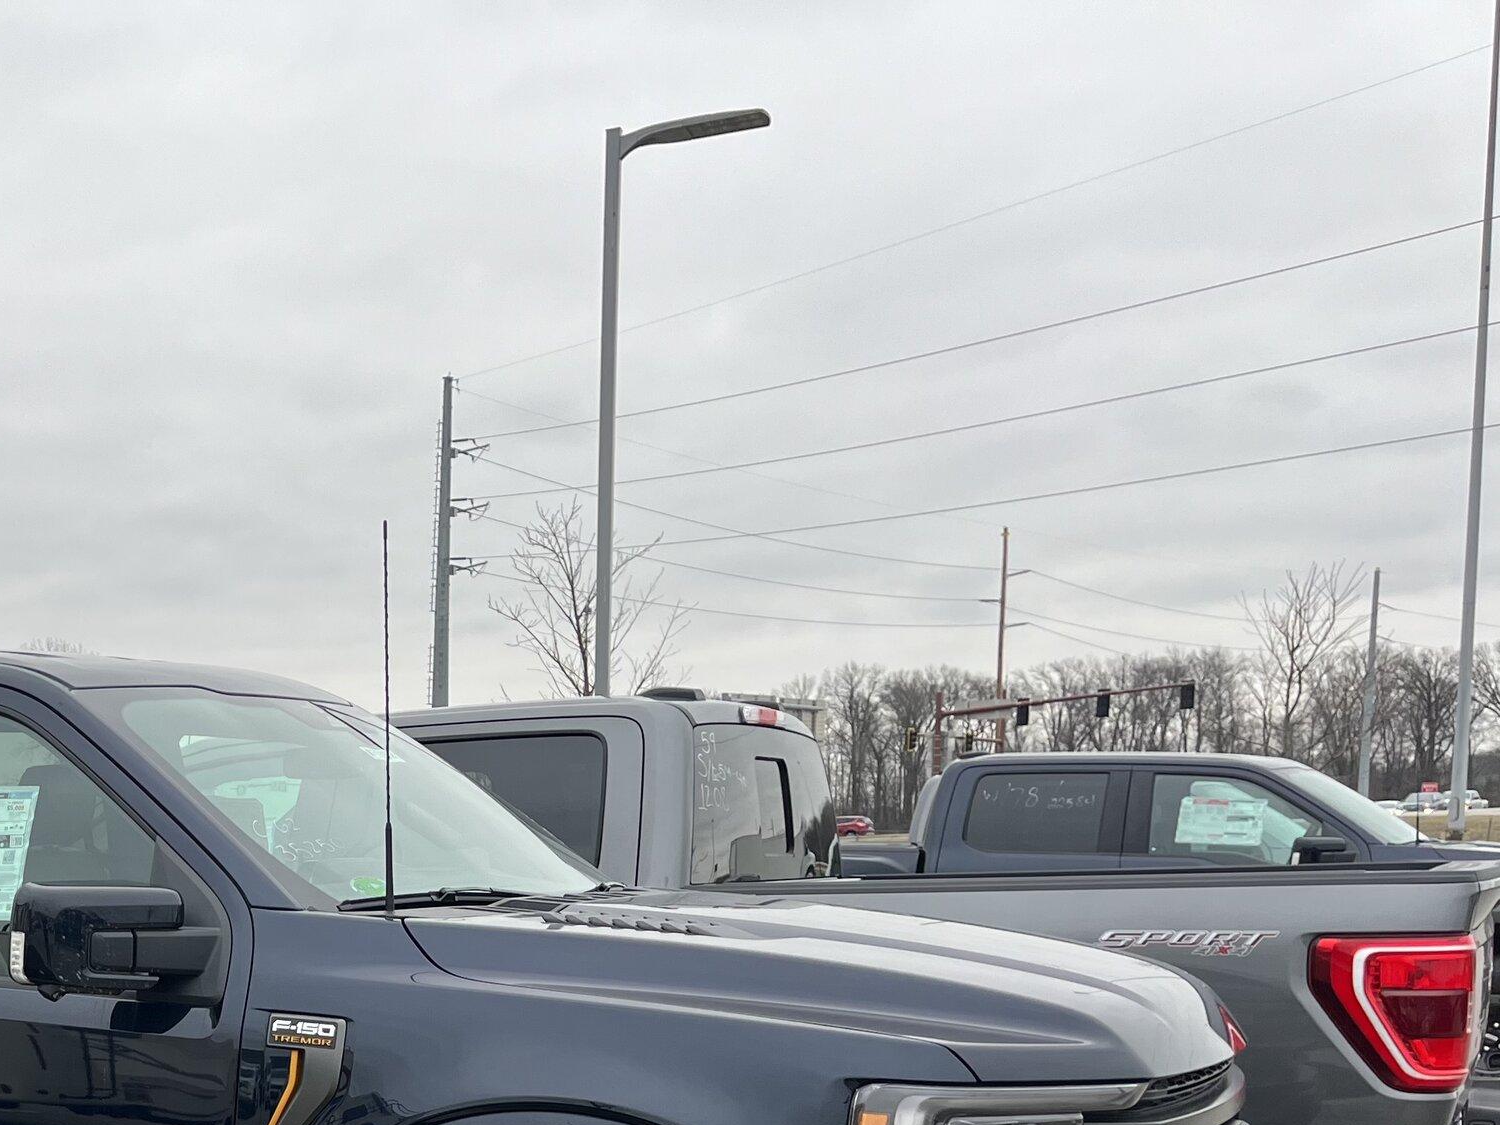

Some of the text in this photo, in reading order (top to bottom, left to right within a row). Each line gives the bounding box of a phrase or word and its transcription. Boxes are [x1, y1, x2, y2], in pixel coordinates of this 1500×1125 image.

[1099, 930, 1280, 948] SPORT
[271, 1019, 336, 1037] F-150
[271, 1033, 332, 1046] TREMOR
